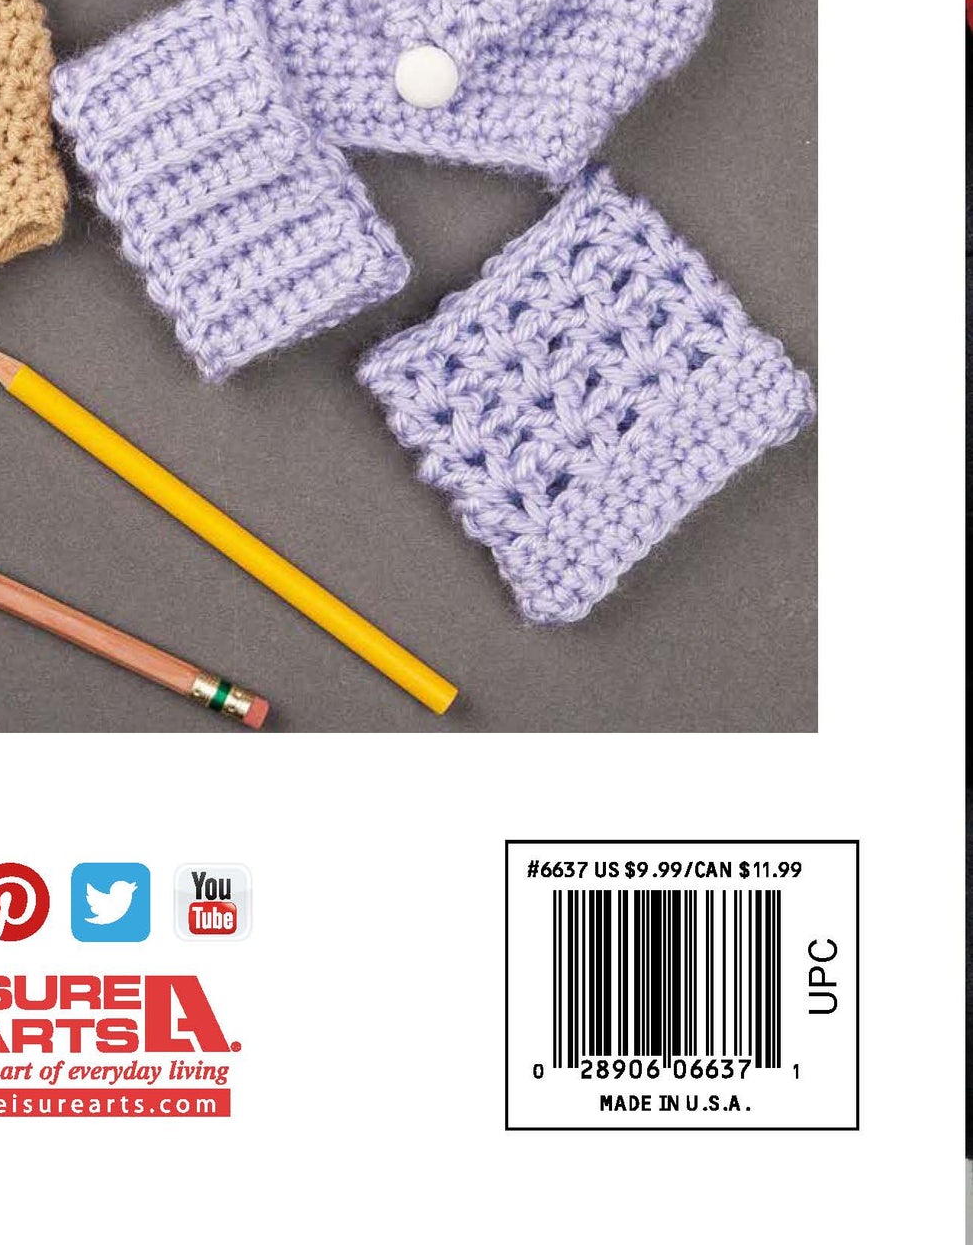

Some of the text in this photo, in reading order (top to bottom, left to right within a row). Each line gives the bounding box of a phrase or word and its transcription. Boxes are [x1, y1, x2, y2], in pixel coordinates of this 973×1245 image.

[527, 860, 588, 879] #6637
[595, 861, 619, 879] US
[739, 861, 802, 880] $11.99
[191, 871, 231, 900] You
[192, 906, 234, 930] Tube
[808, 938, 838, 1015] UPC
[0, 1063, 33, 1081] art
[40, 1059, 65, 1086] of
[69, 1059, 163, 1086] everyday
[169, 1059, 230, 1086] living
[580, 1059, 660, 1080] 28906
[673, 1059, 752, 1080] 06637
[600, 1095, 751, 1112] MADE IN U.S.A.
